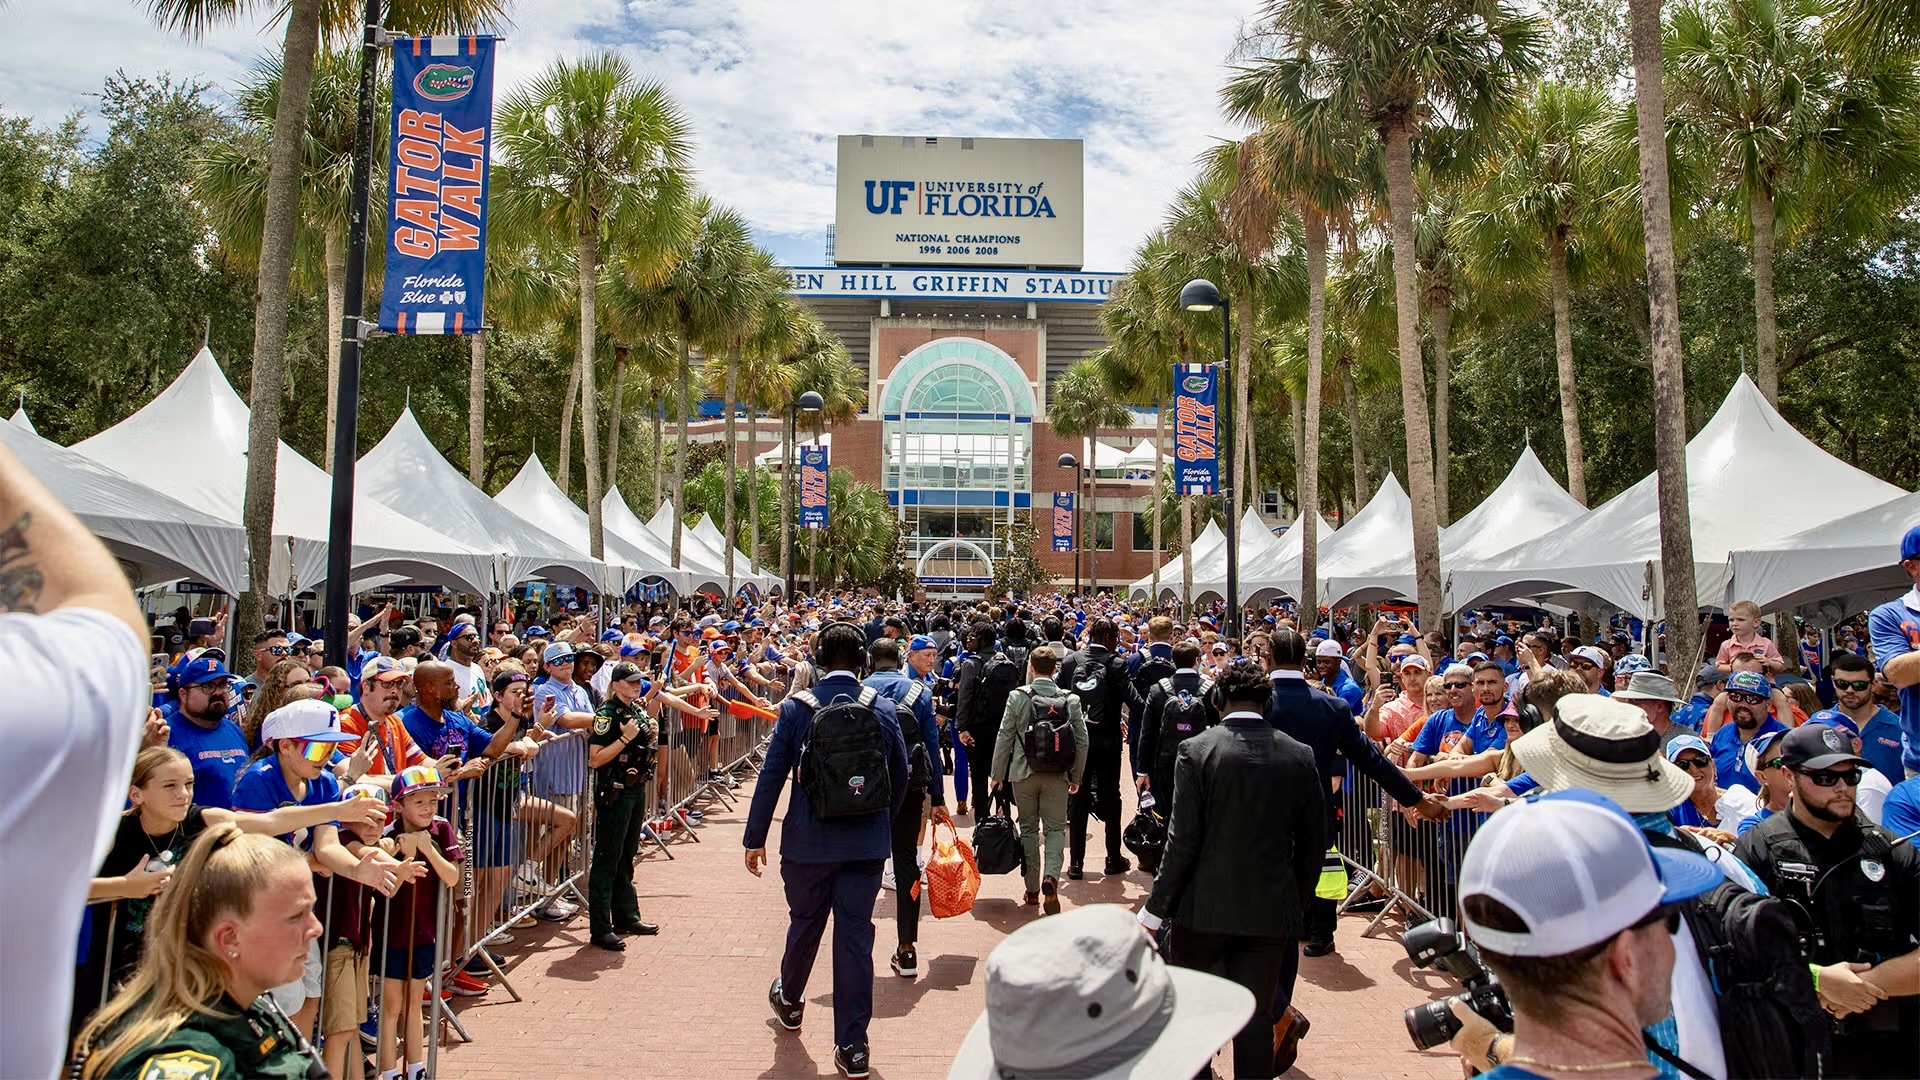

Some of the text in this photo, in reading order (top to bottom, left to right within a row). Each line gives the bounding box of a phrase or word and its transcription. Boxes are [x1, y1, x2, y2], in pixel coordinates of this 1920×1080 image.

[394, 108, 442, 260] GATOR
[438, 119, 485, 253] WALK
[924, 181, 1044, 197] UNIVERSITY of
[864, 180, 915, 214] UF
[924, 193, 1056, 218] FLORIDA
[895, 233, 1020, 245] NATIONAL CHAMPIONS
[919, 245, 998, 256] 1996 2006 2008
[402, 273, 465, 290] Florida
[789, 273, 1113, 296] EN HILL GRIFFIN STADIU
[400, 290, 436, 305] Blue
[1176, 395, 1197, 463] GATOR
[1196, 401, 1216, 460] WALK
[1182, 468, 1211, 476] Florida
[801, 465, 815, 508] GATOR
[813, 469, 827, 507] WALK
[207, 659, 219, 672] F
[328, 710, 337, 728] F
[464, 849, 473, 897] BARRICADES
